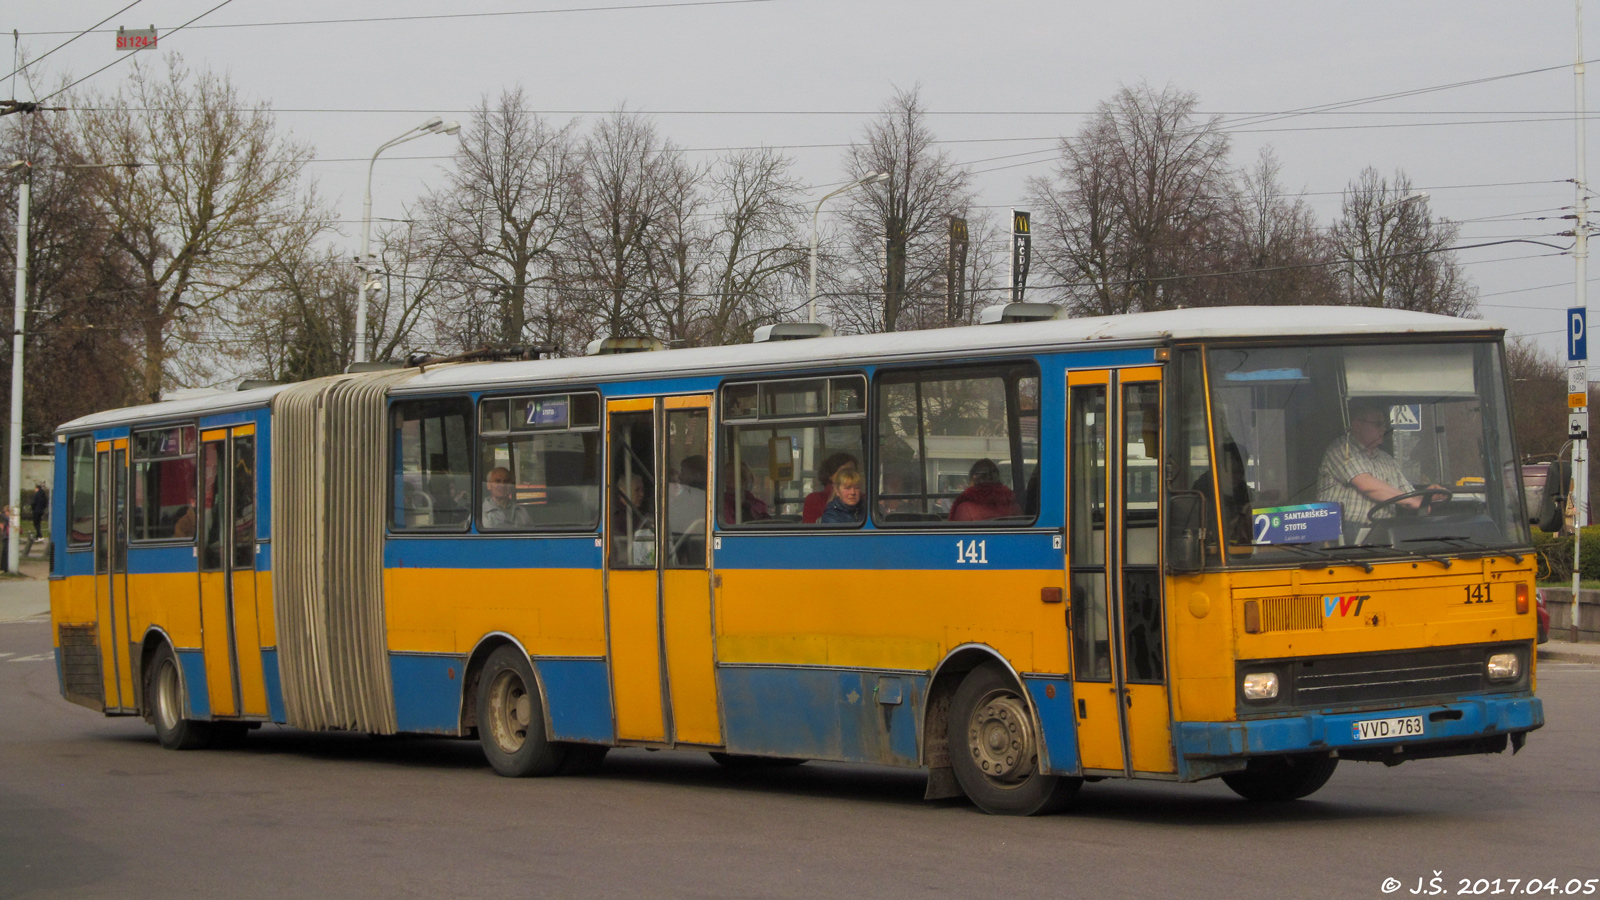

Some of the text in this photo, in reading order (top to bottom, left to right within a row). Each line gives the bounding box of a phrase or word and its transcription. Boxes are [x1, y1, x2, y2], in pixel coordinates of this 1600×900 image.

[1572, 313, 1584, 355] P
[527, 401, 535, 424] 2
[1284, 509, 1328, 520] SANTARIŠKĖS
[1254, 514, 1279, 545] 2 G
[1284, 523, 1307, 531] STOTIS
[956, 540, 988, 564] 141
[1464, 583, 1493, 604] 141
[1324, 595, 1371, 617] VVT
[1361, 721, 1389, 738] VVD
[1397, 718, 1421, 735] 763
